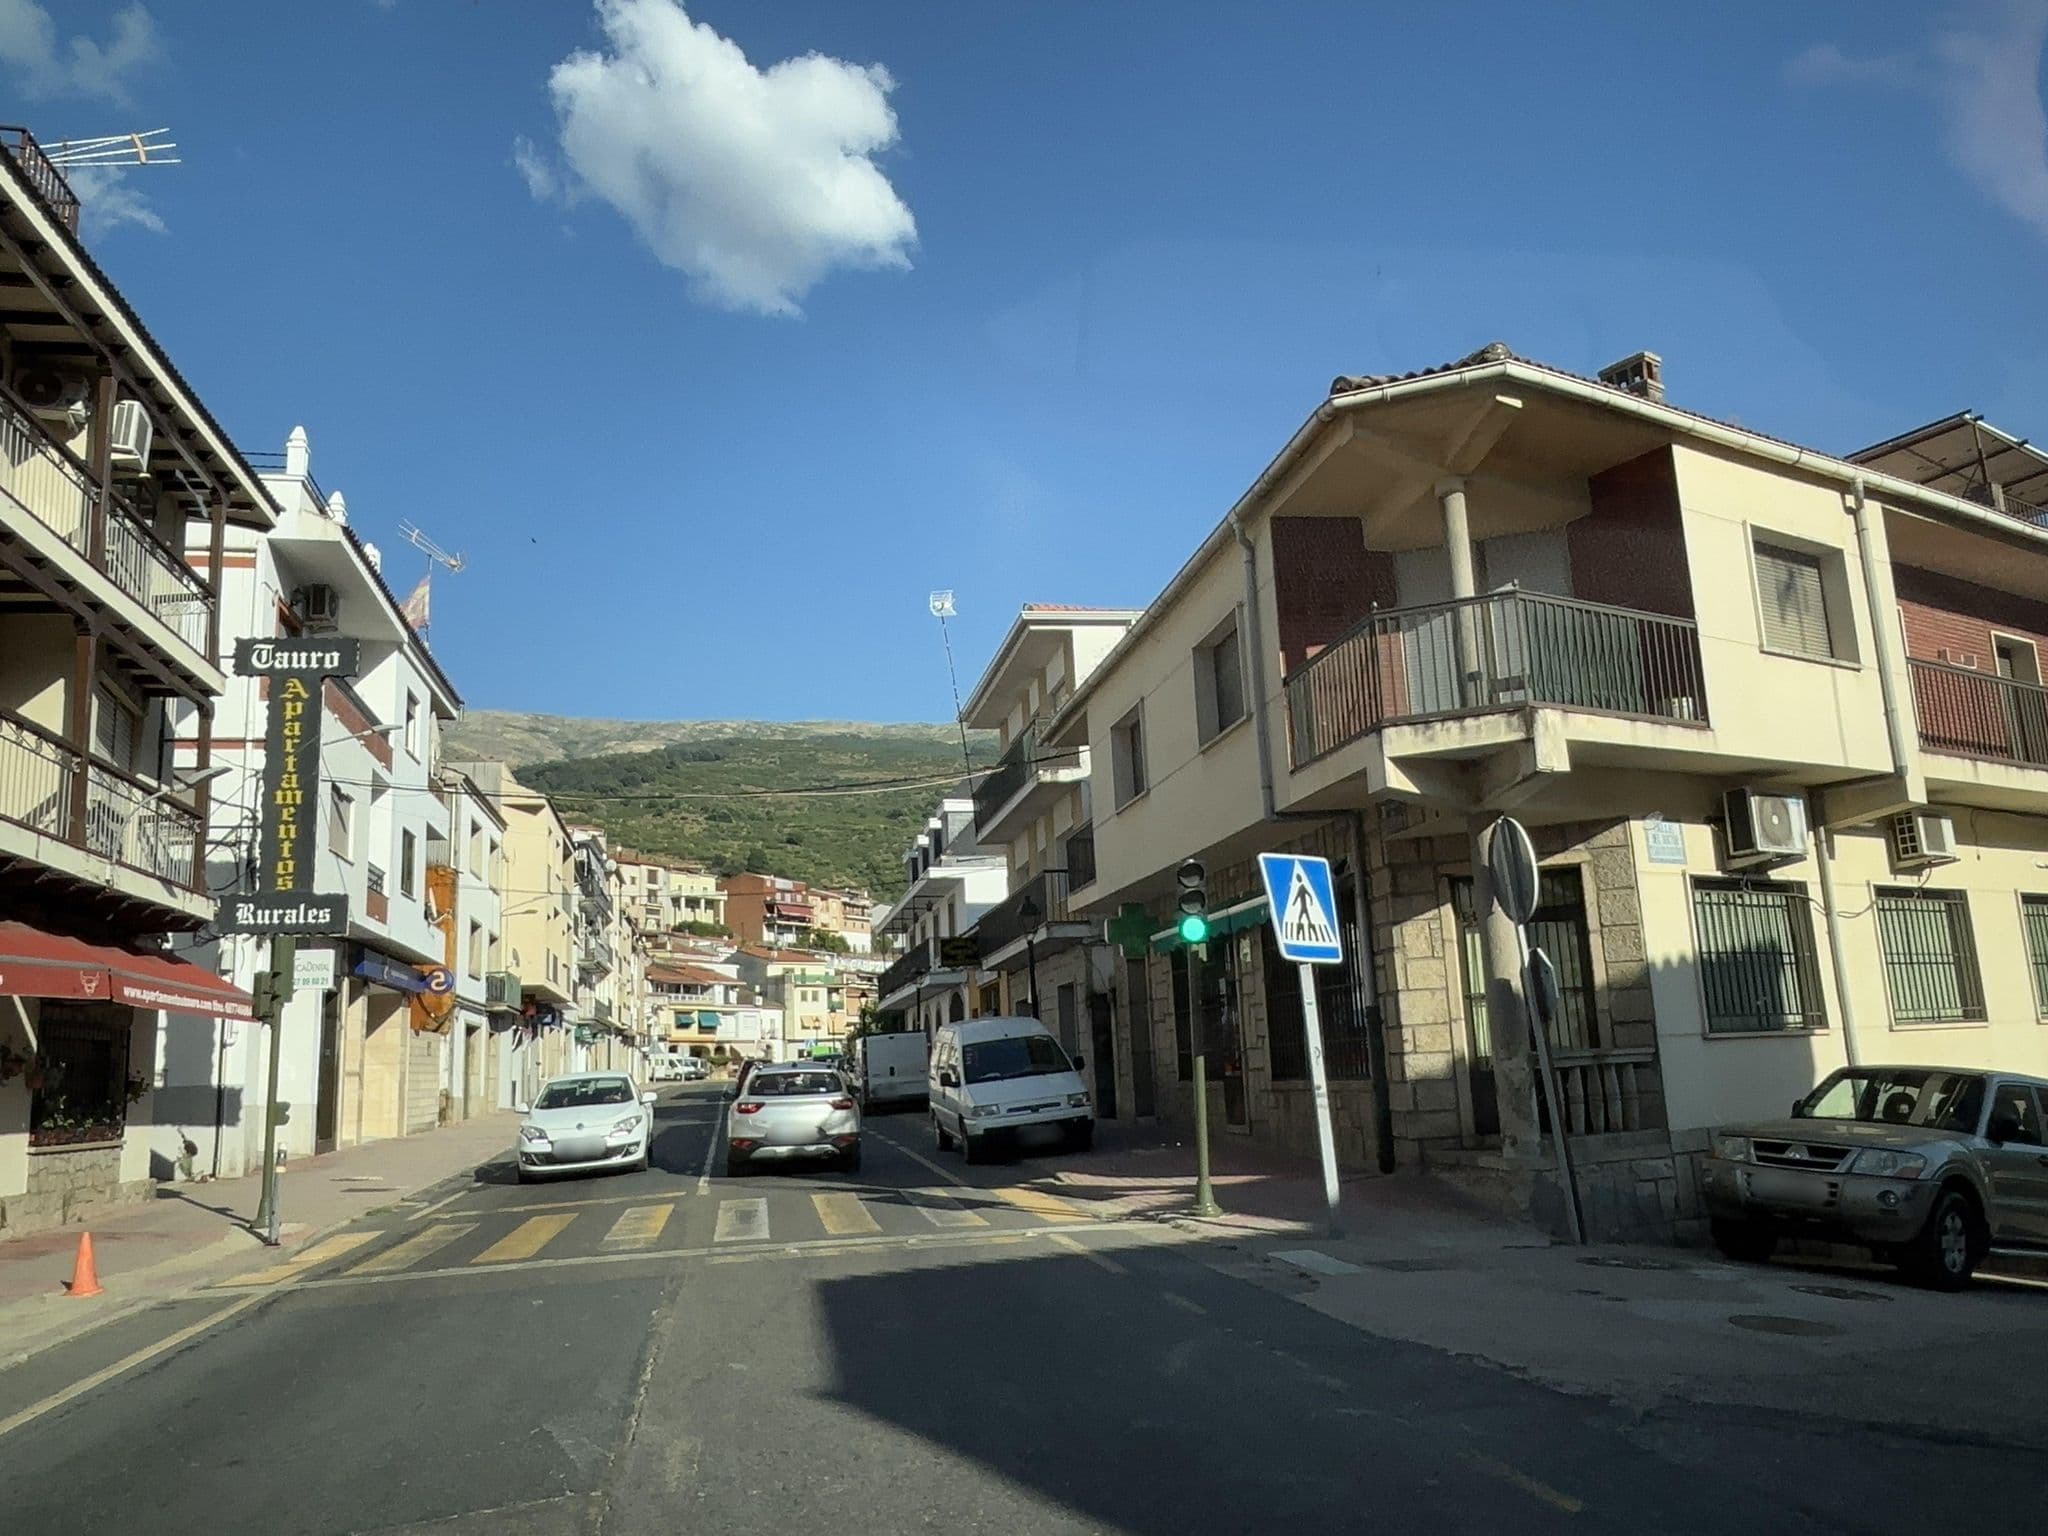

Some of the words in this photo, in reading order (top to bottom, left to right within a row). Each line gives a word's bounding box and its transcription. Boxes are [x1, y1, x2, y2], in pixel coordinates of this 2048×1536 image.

[251, 643, 341, 669] Tauro
[274, 677, 310, 892] Apartamentos
[235, 903, 332, 924] Rurales
